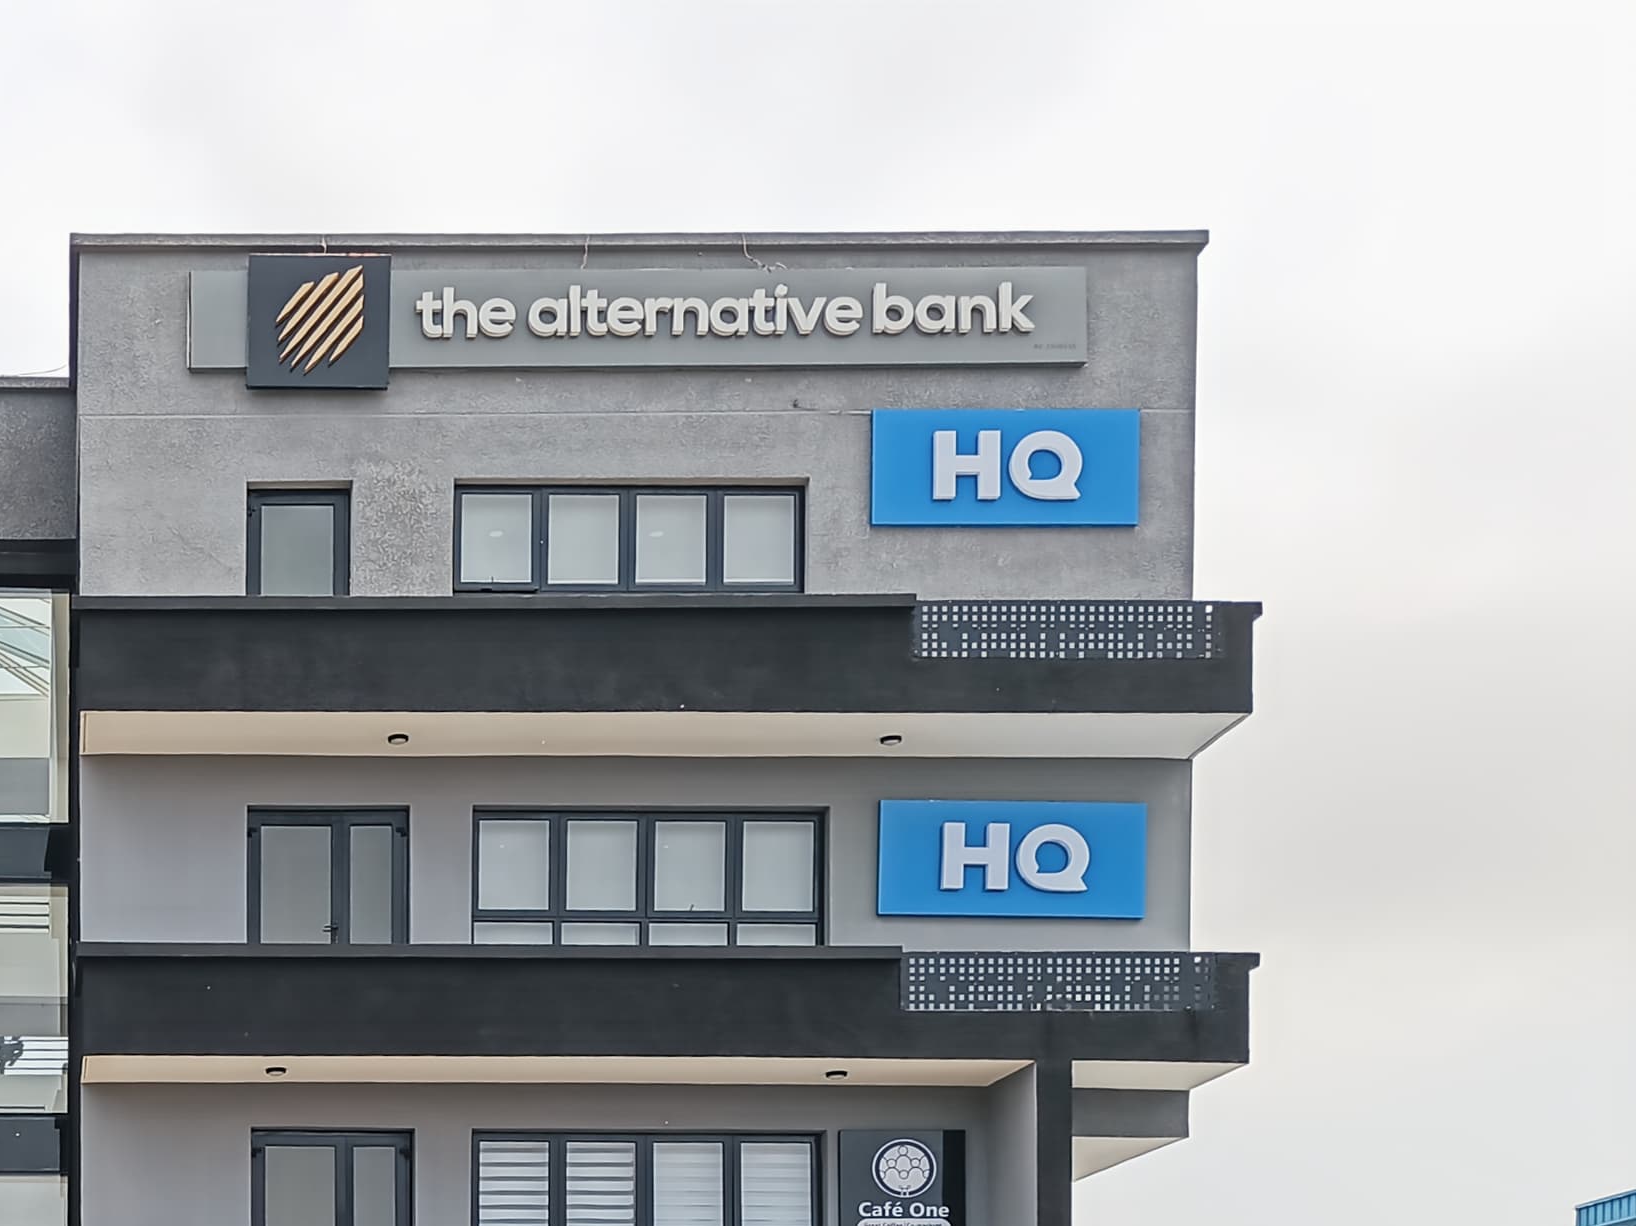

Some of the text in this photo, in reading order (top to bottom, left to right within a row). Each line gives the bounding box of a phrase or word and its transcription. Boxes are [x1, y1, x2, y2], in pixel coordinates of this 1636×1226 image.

[415, 282, 1035, 338] the alternative bank
[932, 430, 1084, 500] HQ
[940, 822, 1090, 892] HQ
[858, 1201, 950, 1218] Café One
